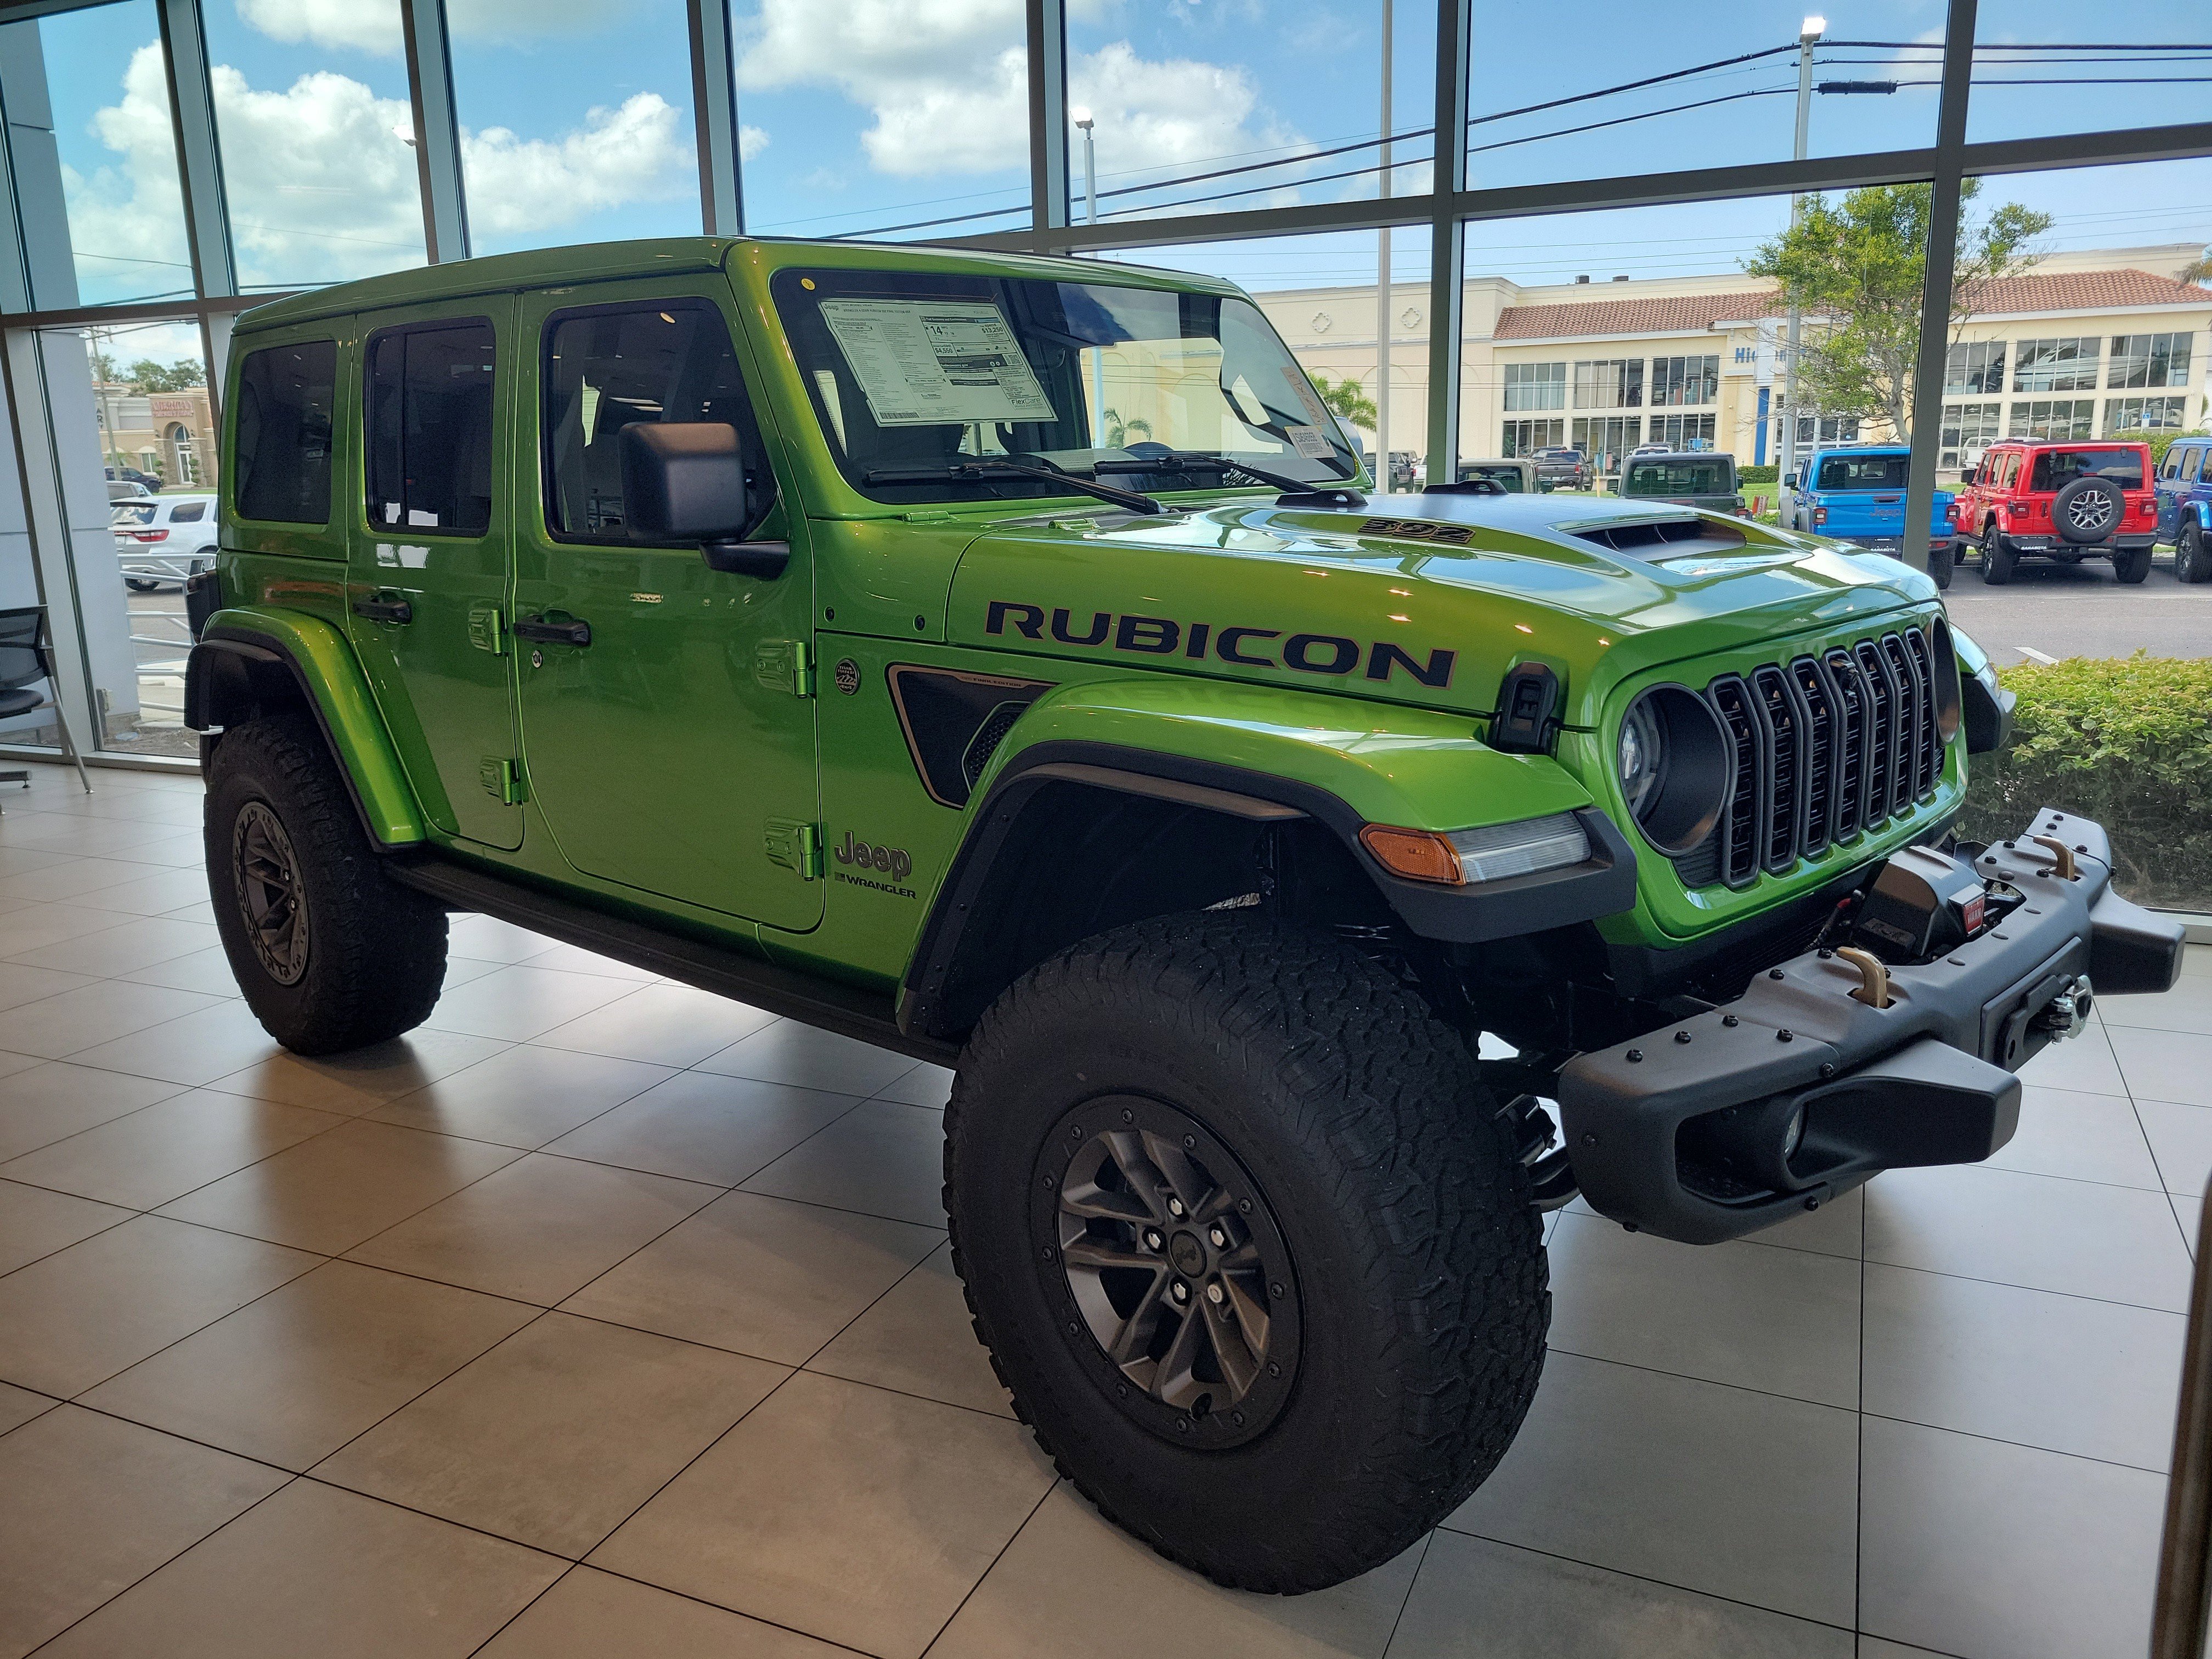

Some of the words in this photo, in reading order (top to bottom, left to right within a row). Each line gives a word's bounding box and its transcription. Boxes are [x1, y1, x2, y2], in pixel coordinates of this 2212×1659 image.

[930, 326, 943, 335] 14
[1358, 518, 1476, 544] 392
[985, 600, 1458, 690] RUBICON
[834, 830, 912, 883] Jeep
[845, 874, 917, 899] WRANGLER
[1967, 907, 1982, 924] WARN
